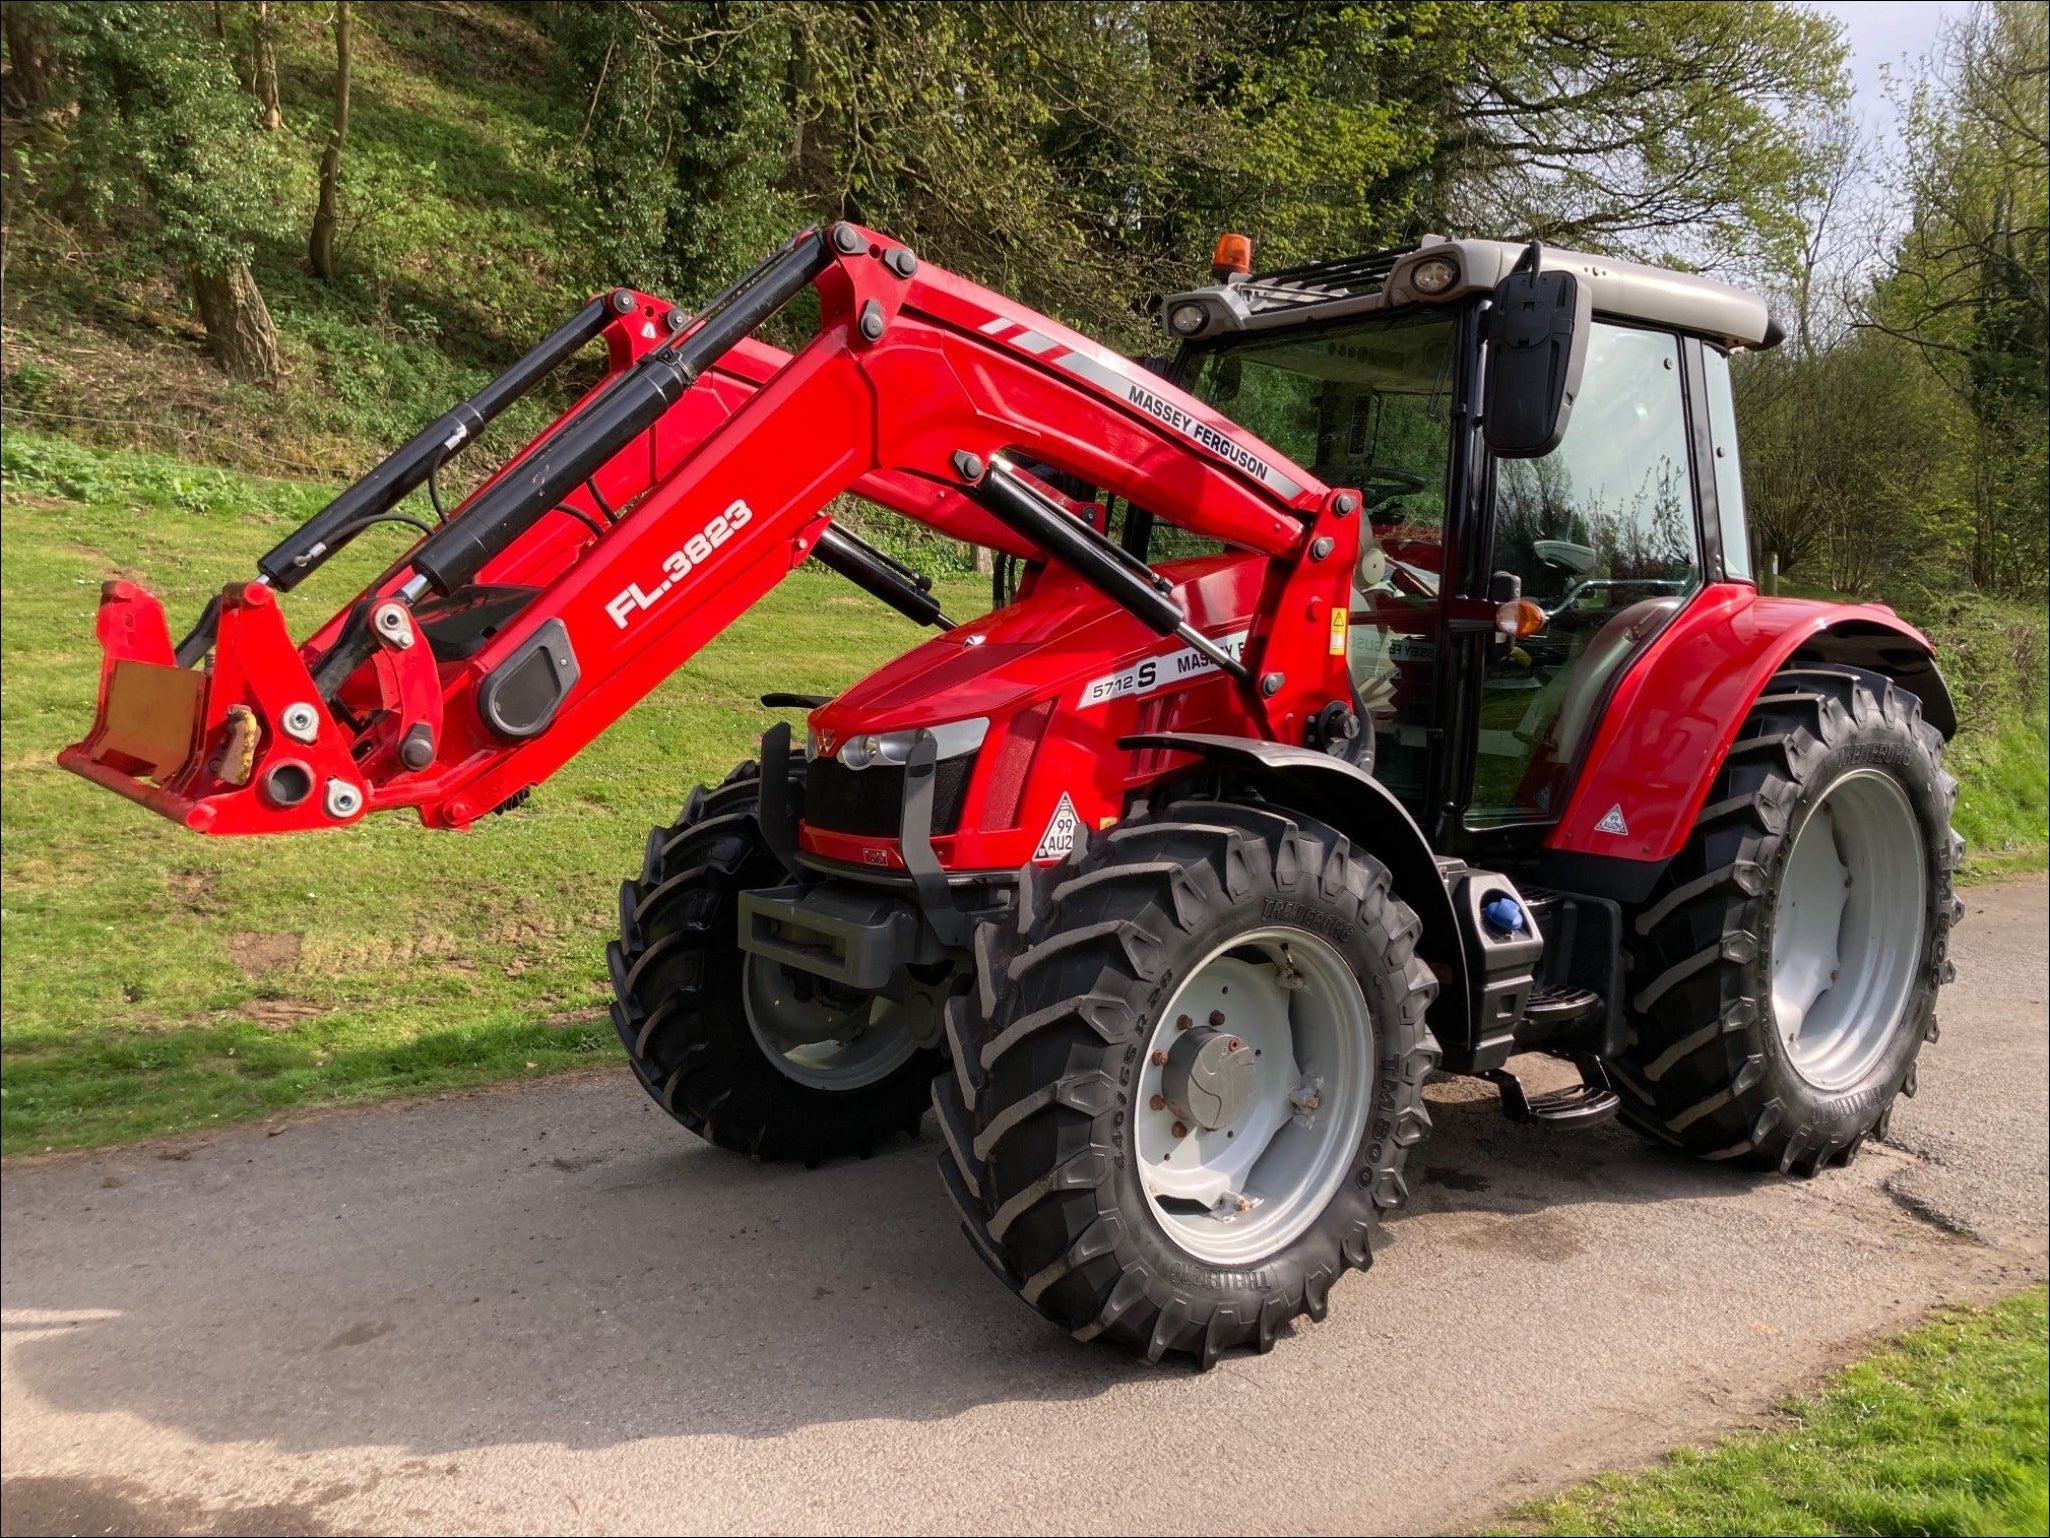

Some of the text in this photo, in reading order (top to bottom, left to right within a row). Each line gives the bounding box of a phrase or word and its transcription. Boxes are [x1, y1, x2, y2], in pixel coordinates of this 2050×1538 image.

[1128, 385, 1268, 481] MASSEY FERGUSON
[604, 498, 753, 630] FL.3823
[1092, 675, 1134, 699] 5712
[1137, 661, 1157, 689] S
[1177, 643, 1233, 674] MASY
[1057, 818, 1073, 835] 99
